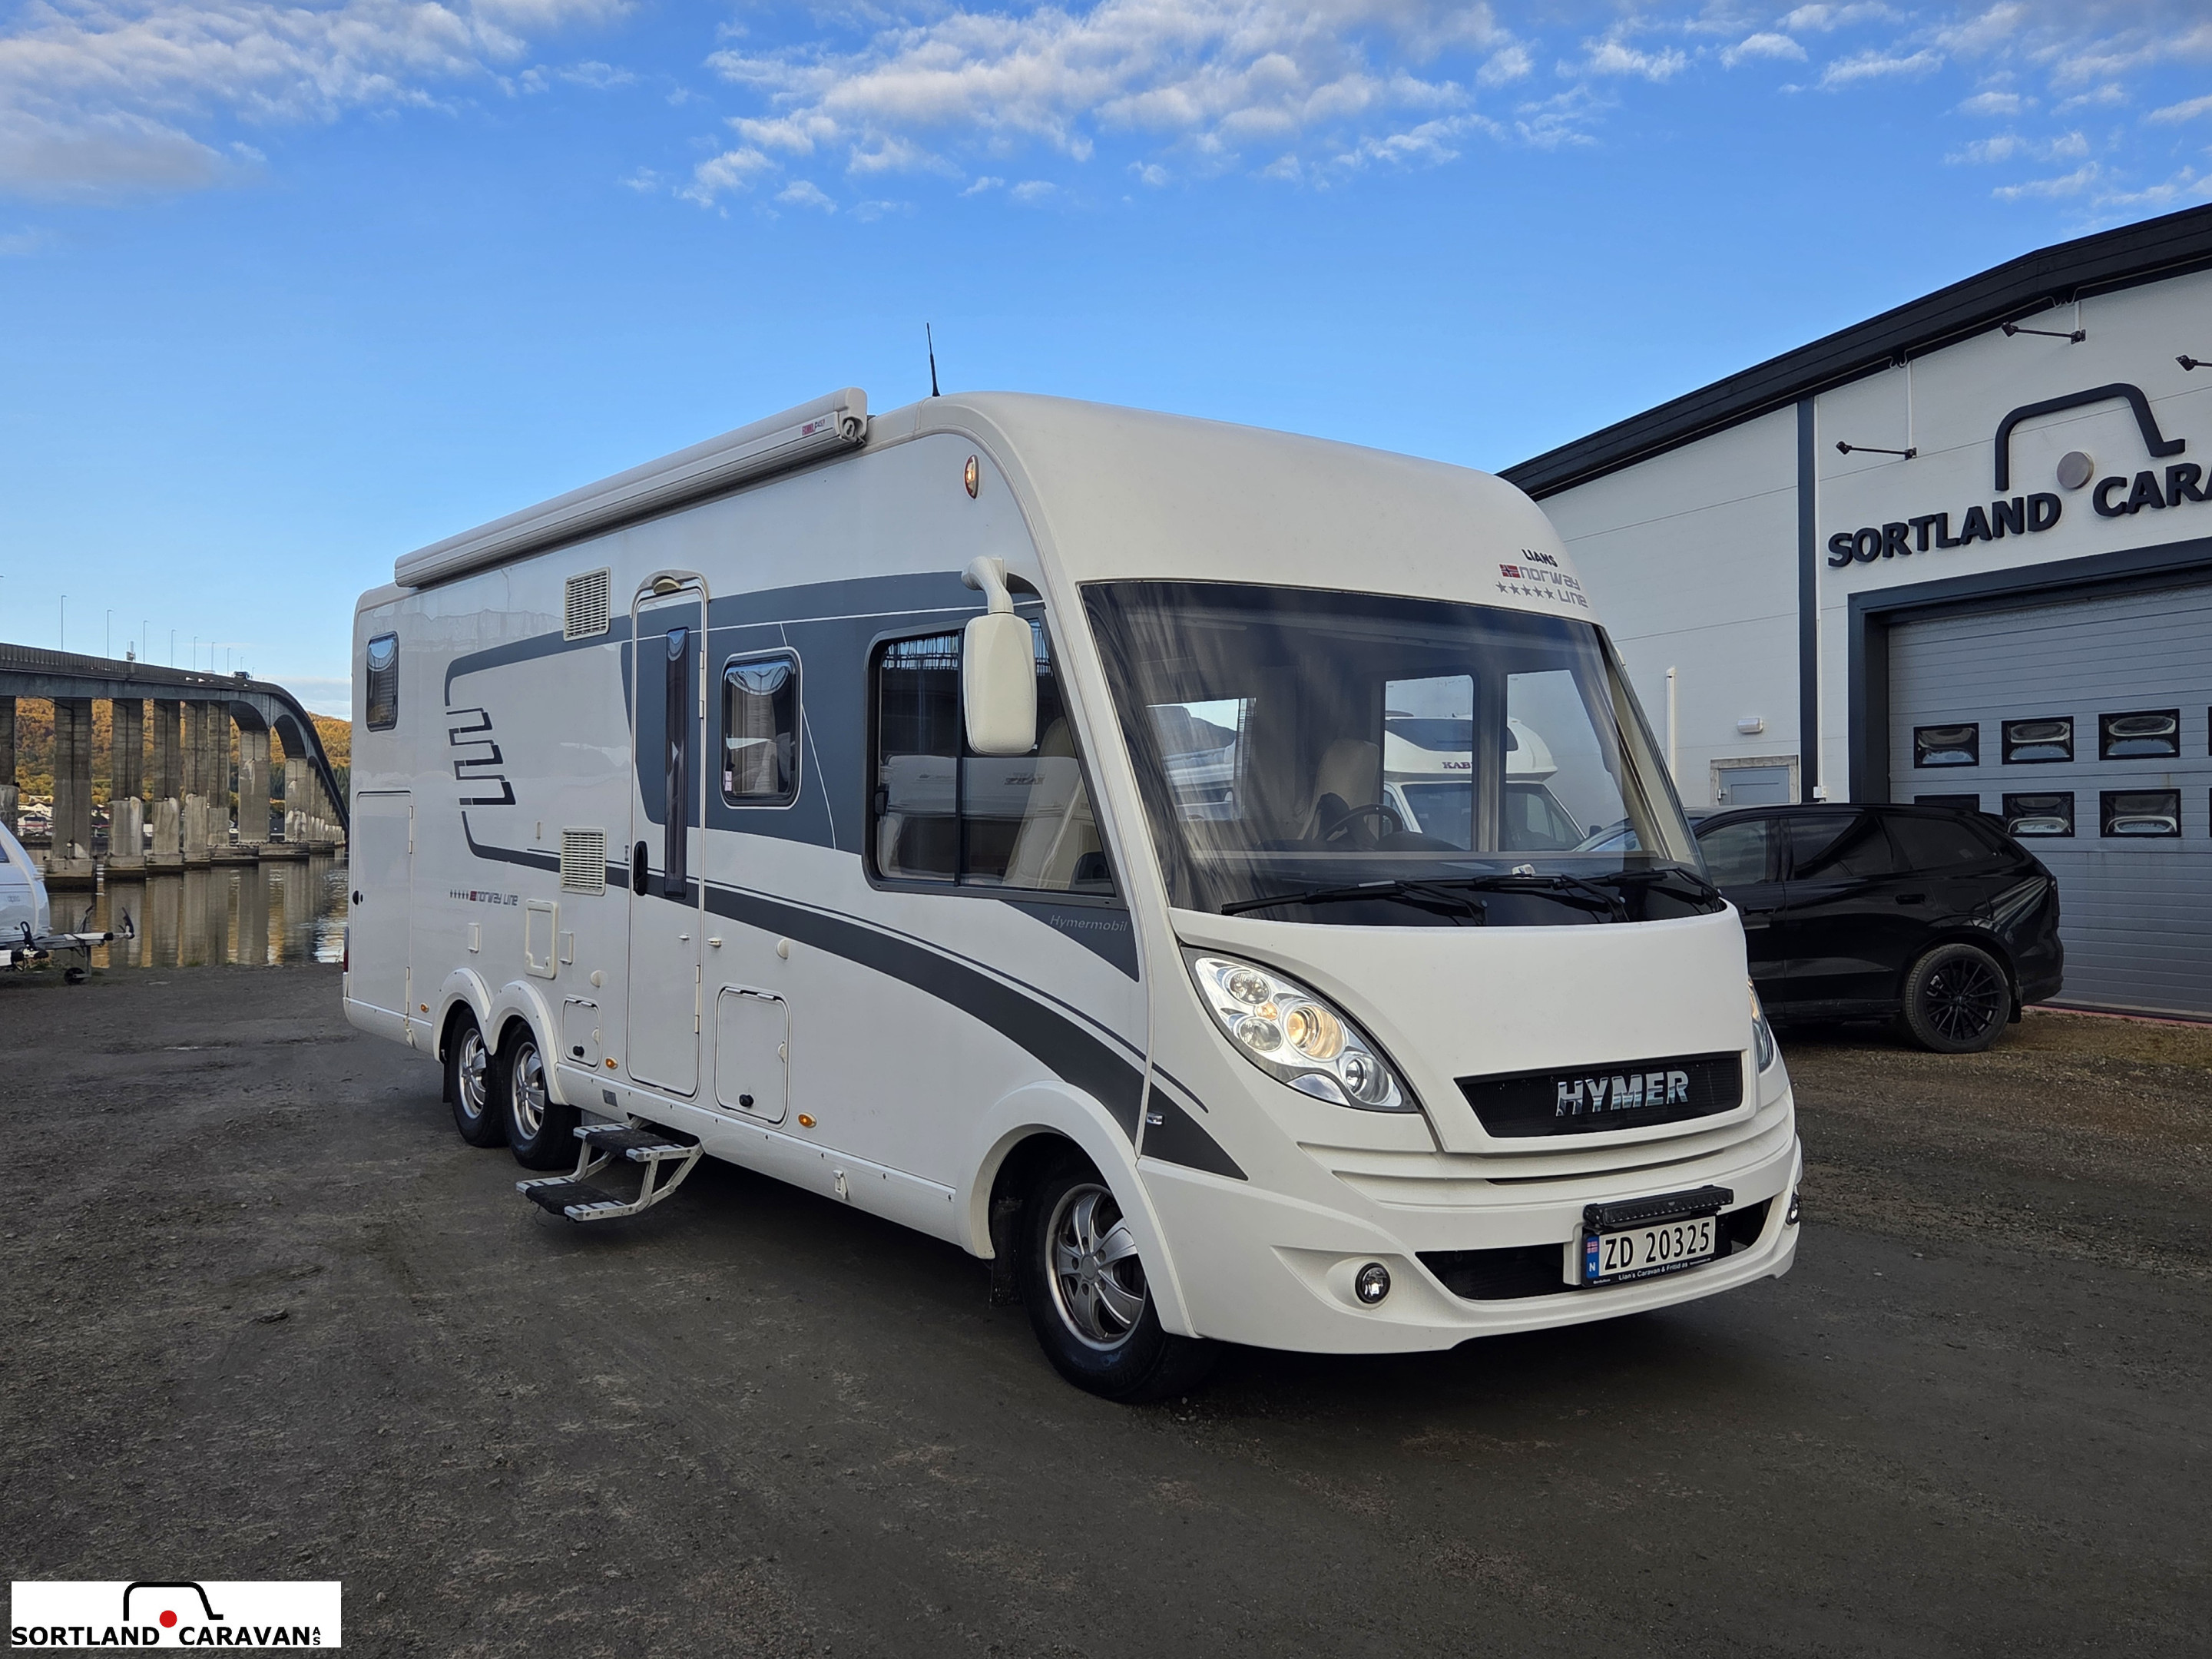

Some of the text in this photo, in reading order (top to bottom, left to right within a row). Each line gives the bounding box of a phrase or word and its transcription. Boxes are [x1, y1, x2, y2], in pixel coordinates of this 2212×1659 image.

[1828, 462, 2212, 568] SORTLAND CAR
[1522, 548, 1558, 568] LIANS
[1518, 565, 1581, 591] norway
[1049, 914, 1128, 932] Hymermobil
[1555, 1070, 1689, 1117] HYMER
[1604, 1222, 1710, 1270] ZD 20325
[1589, 1262, 1596, 1272] N
[1637, 1267, 1661, 1277] Caravan
